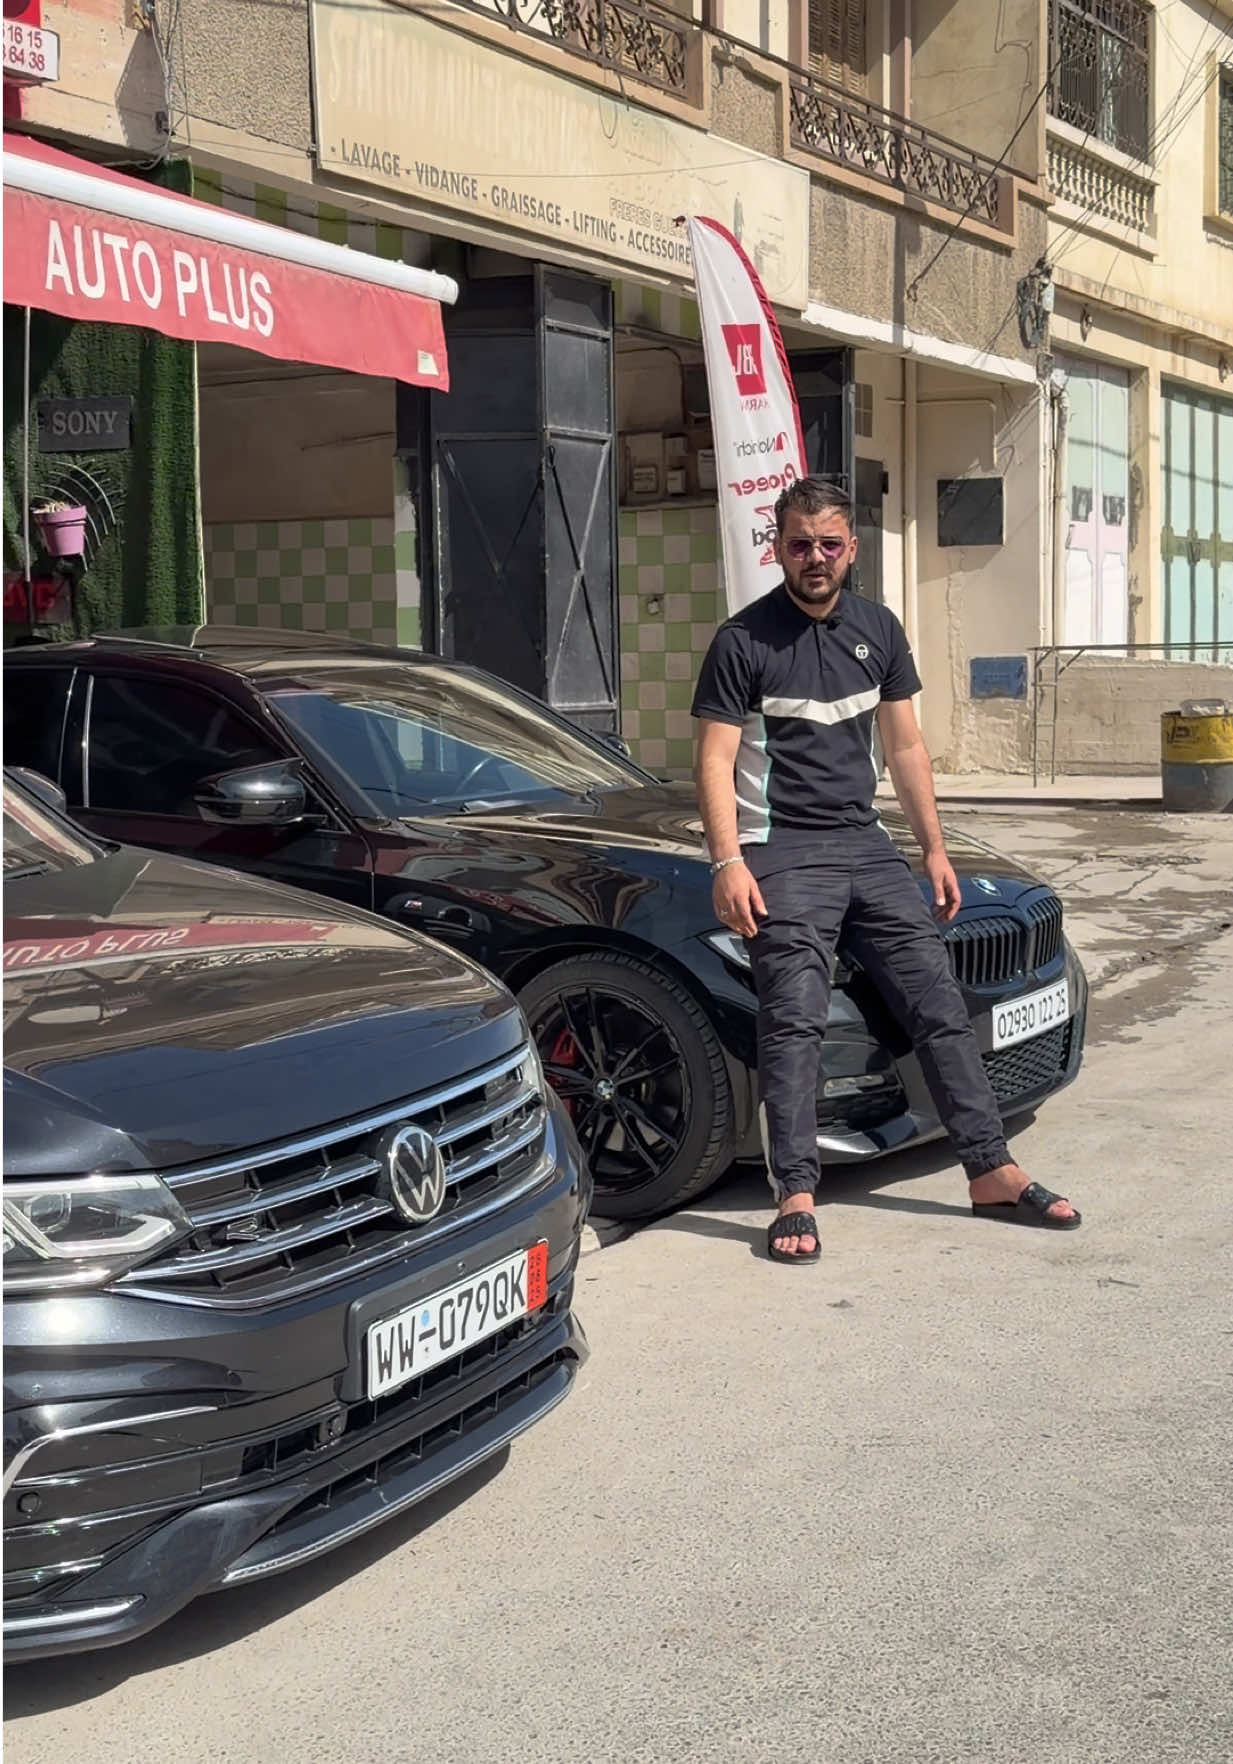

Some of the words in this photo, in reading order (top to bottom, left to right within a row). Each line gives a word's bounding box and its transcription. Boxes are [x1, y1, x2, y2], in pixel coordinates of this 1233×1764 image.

[8, 25, 23, 44] 16
[27, 31, 43, 49] 15
[29, 51, 45, 71] 38
[341, 138, 401, 177] LAVAGE
[415, 161, 478, 200] VIDANGE
[491, 185, 562, 226] GRAISSAGE
[573, 210, 617, 242] LIFTING
[627, 228, 693, 265] ACCESSOIRE
[45, 219, 163, 310] AUTO
[173, 249, 274, 337] PLUS
[52, 410, 119, 436] SONY
[998, 1003, 1036, 1039] 02930
[1039, 995, 1054, 1025] 122
